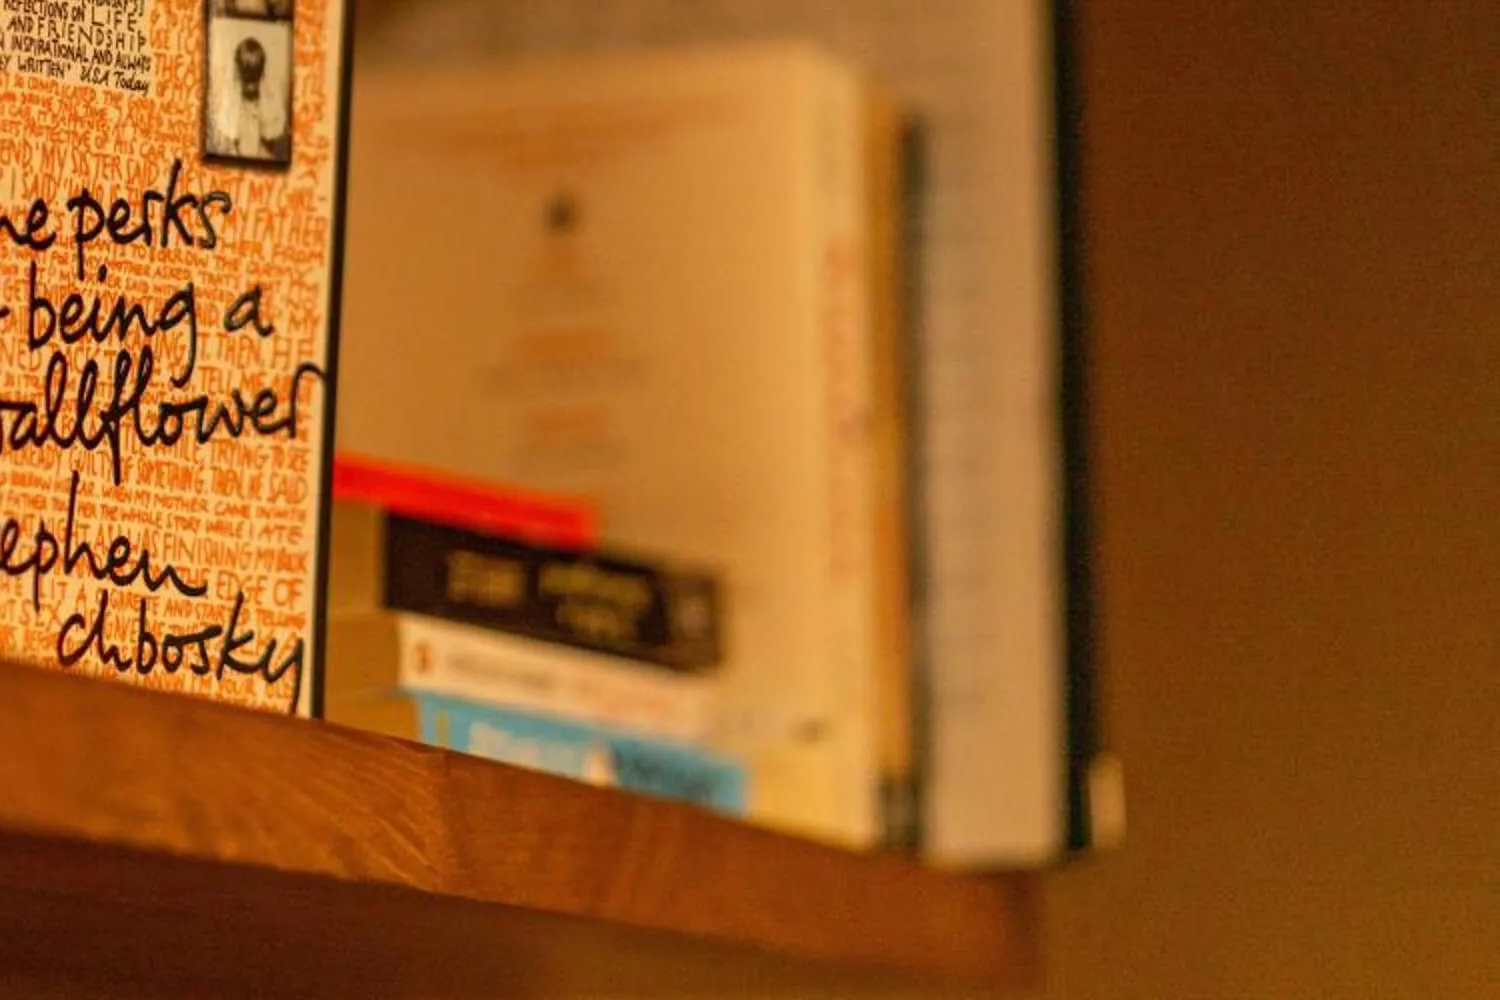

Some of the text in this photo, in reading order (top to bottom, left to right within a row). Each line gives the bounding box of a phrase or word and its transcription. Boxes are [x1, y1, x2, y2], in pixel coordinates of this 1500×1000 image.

[7, 14, 34, 35] AND
[37, 14, 147, 54] FRIENDSHIP
[91, 47, 113, 67] AND
[114, 70, 150, 97] Today
[66, 158, 233, 281] perks
[26, 264, 198, 386] being
[222, 284, 276, 339] a
